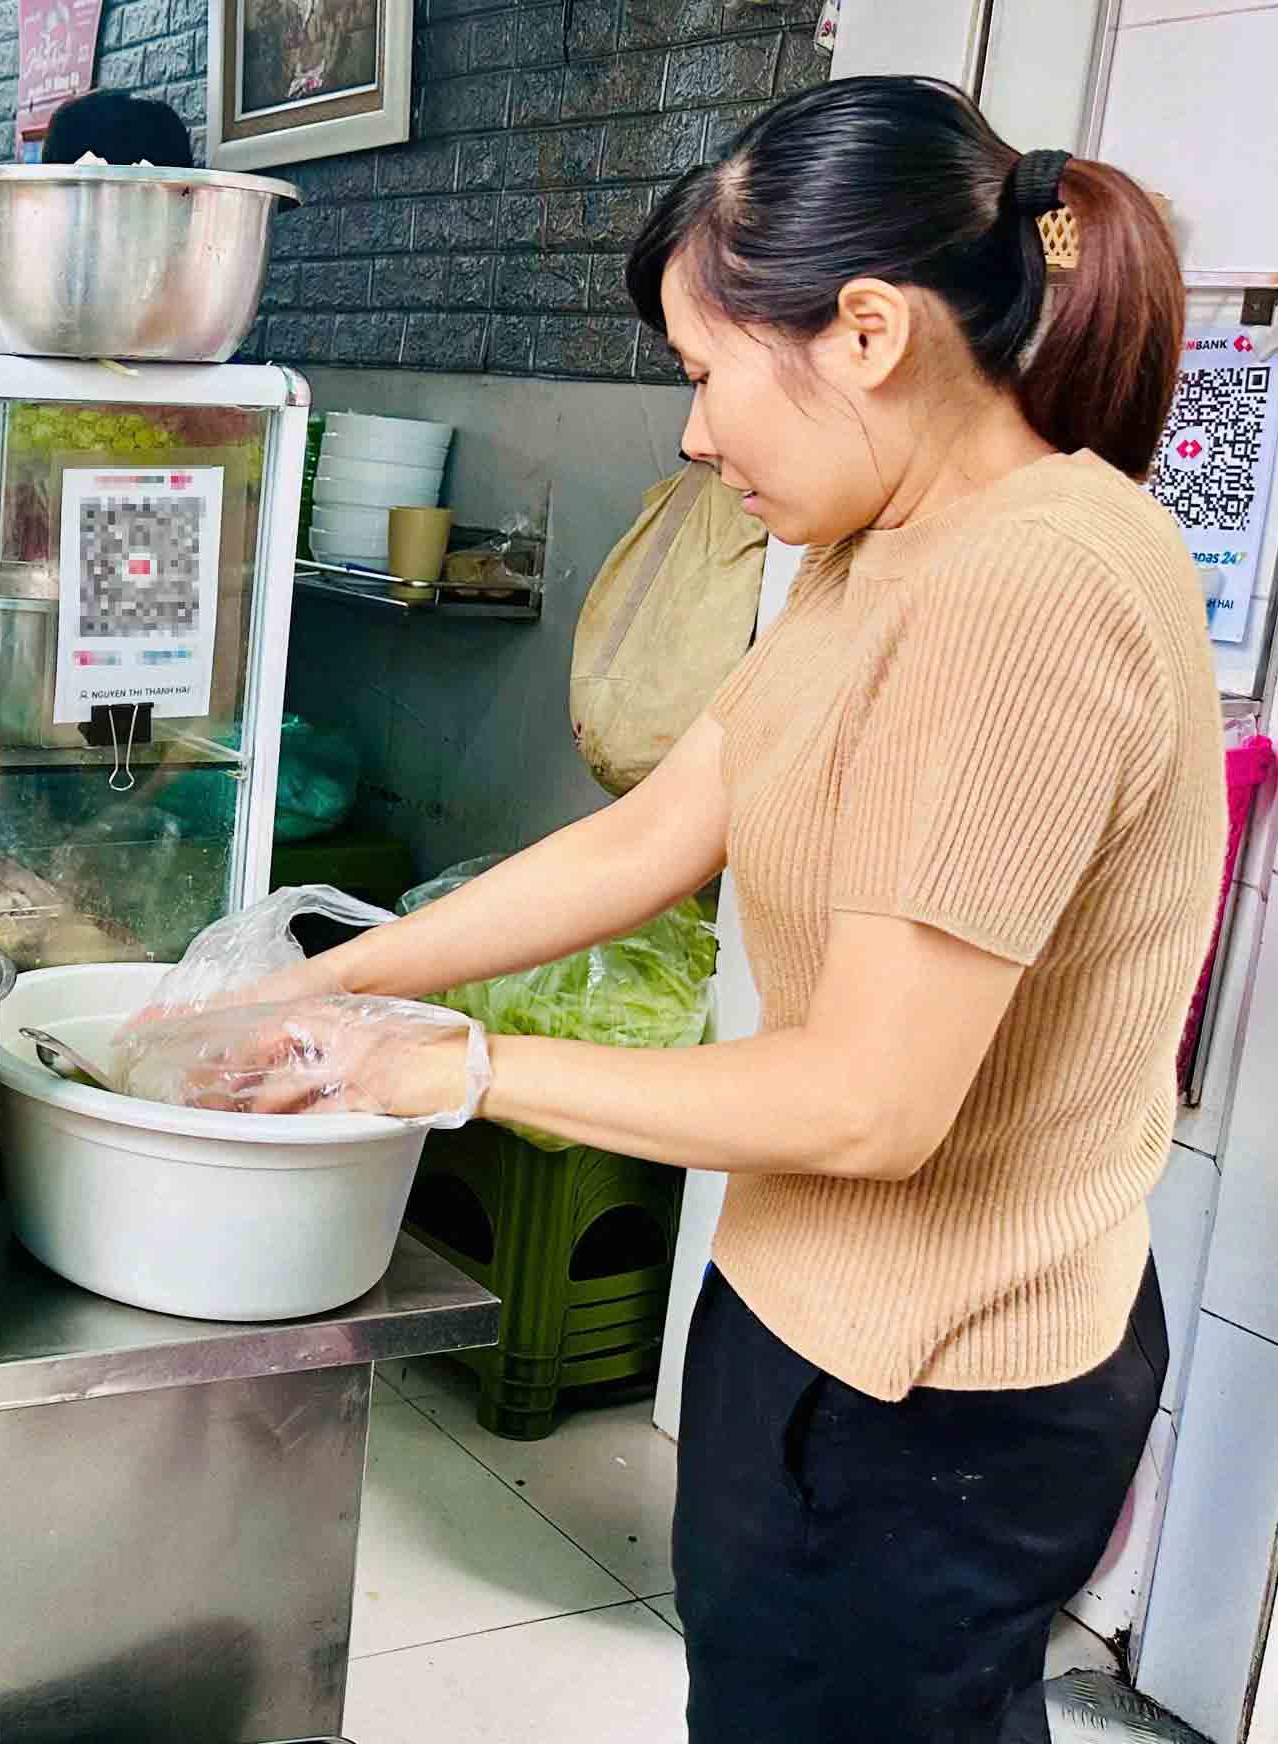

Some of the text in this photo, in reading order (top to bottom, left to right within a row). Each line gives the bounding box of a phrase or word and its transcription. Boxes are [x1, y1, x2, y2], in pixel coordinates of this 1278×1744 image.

[1185, 339, 1227, 350] MBANK
[91, 689, 126, 699] NGUYEN
[129, 688, 142, 697] THI
[145, 687, 174, 696] THANH
